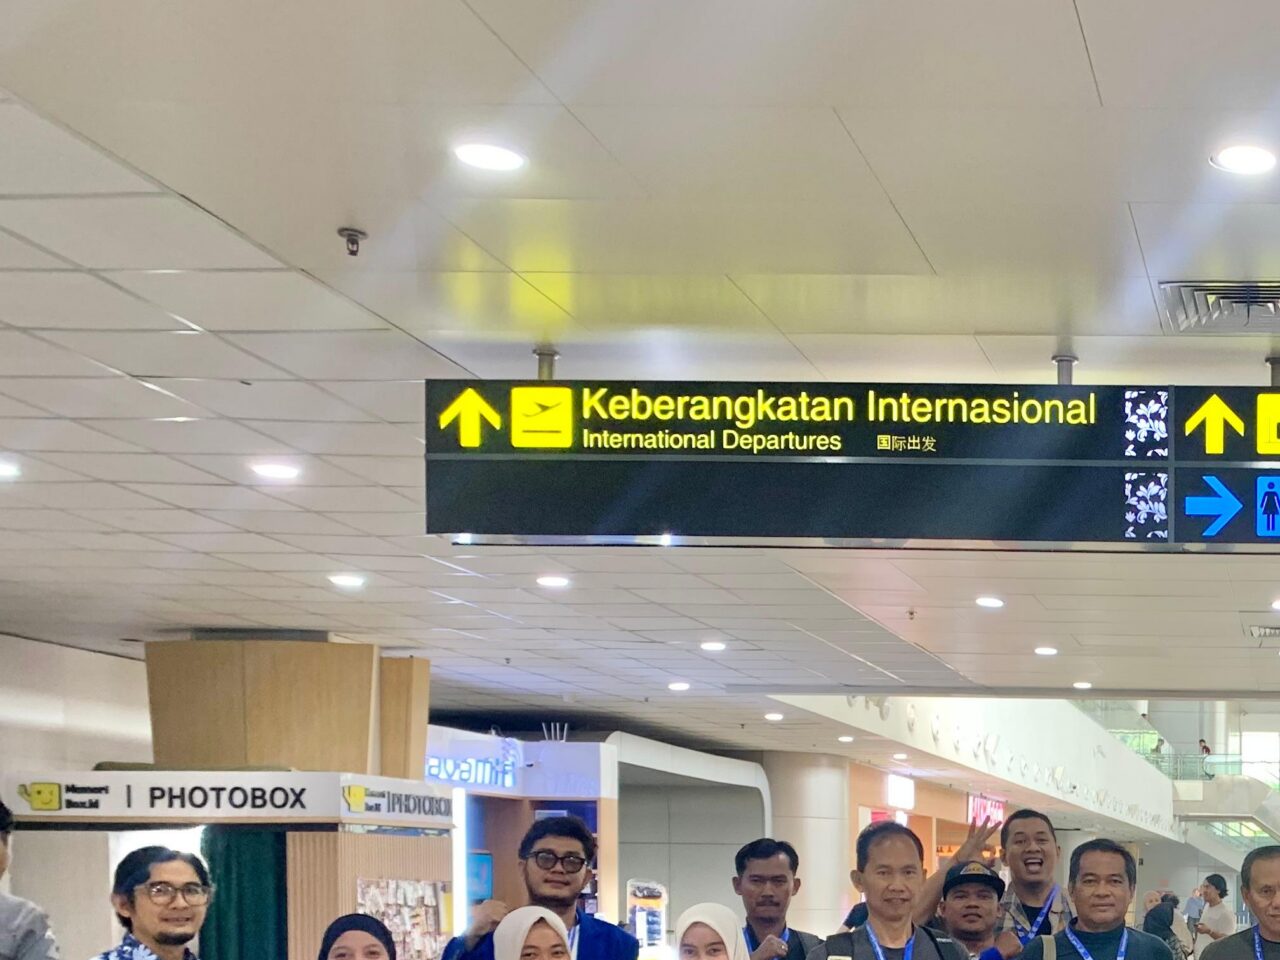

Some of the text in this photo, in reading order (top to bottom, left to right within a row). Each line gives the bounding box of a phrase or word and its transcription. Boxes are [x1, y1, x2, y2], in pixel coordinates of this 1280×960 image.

[582, 387, 1096, 429] Keberangkatan Internasional
[583, 428, 842, 454] International Departures
[877, 434, 937, 452] 国际出发
[149, 786, 307, 809] PHOTOBOX
